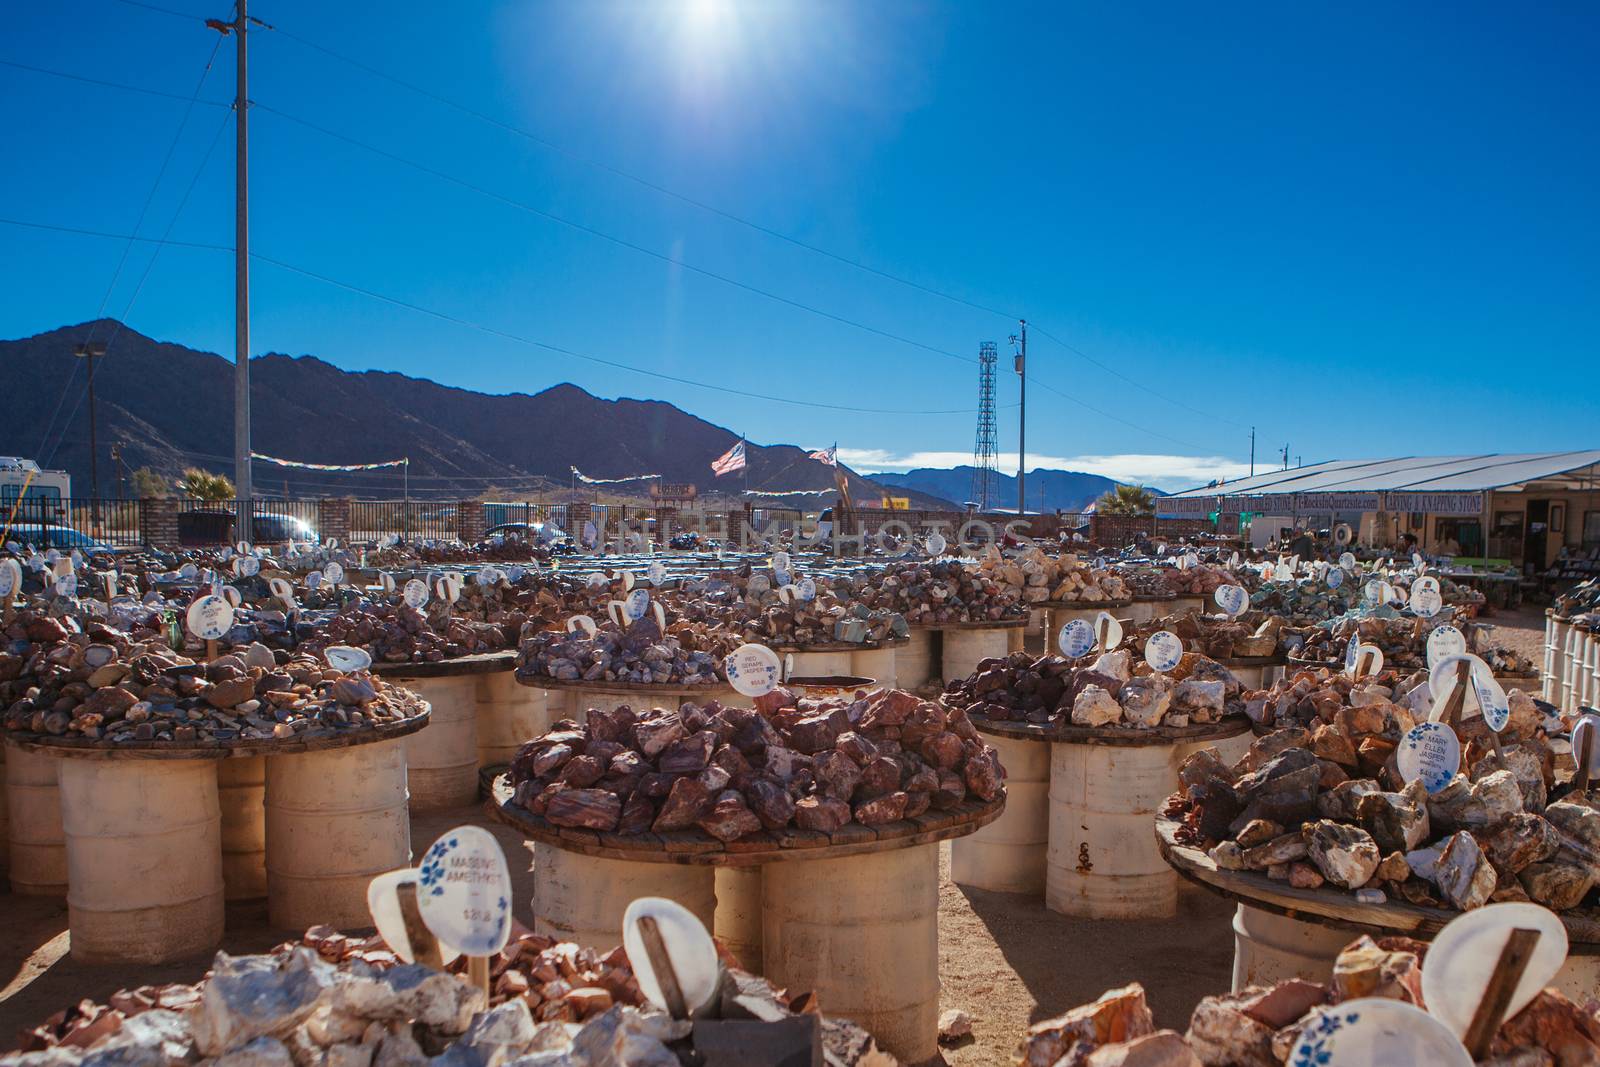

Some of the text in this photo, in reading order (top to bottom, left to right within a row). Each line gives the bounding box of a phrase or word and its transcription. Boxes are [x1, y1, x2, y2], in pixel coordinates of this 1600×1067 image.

[1273, 497, 1291, 511] STONE
[1385, 495, 1412, 511] CARVING
[1422, 495, 1457, 511] KNAPPING
[1459, 495, 1482, 511] STONE
[1428, 735, 1448, 746] MARY
[1423, 743, 1446, 755] ELLEN
[1419, 751, 1446, 763] JASPER
[450, 857, 496, 870] MASSIVE
[447, 871, 501, 884] AMETHYST
